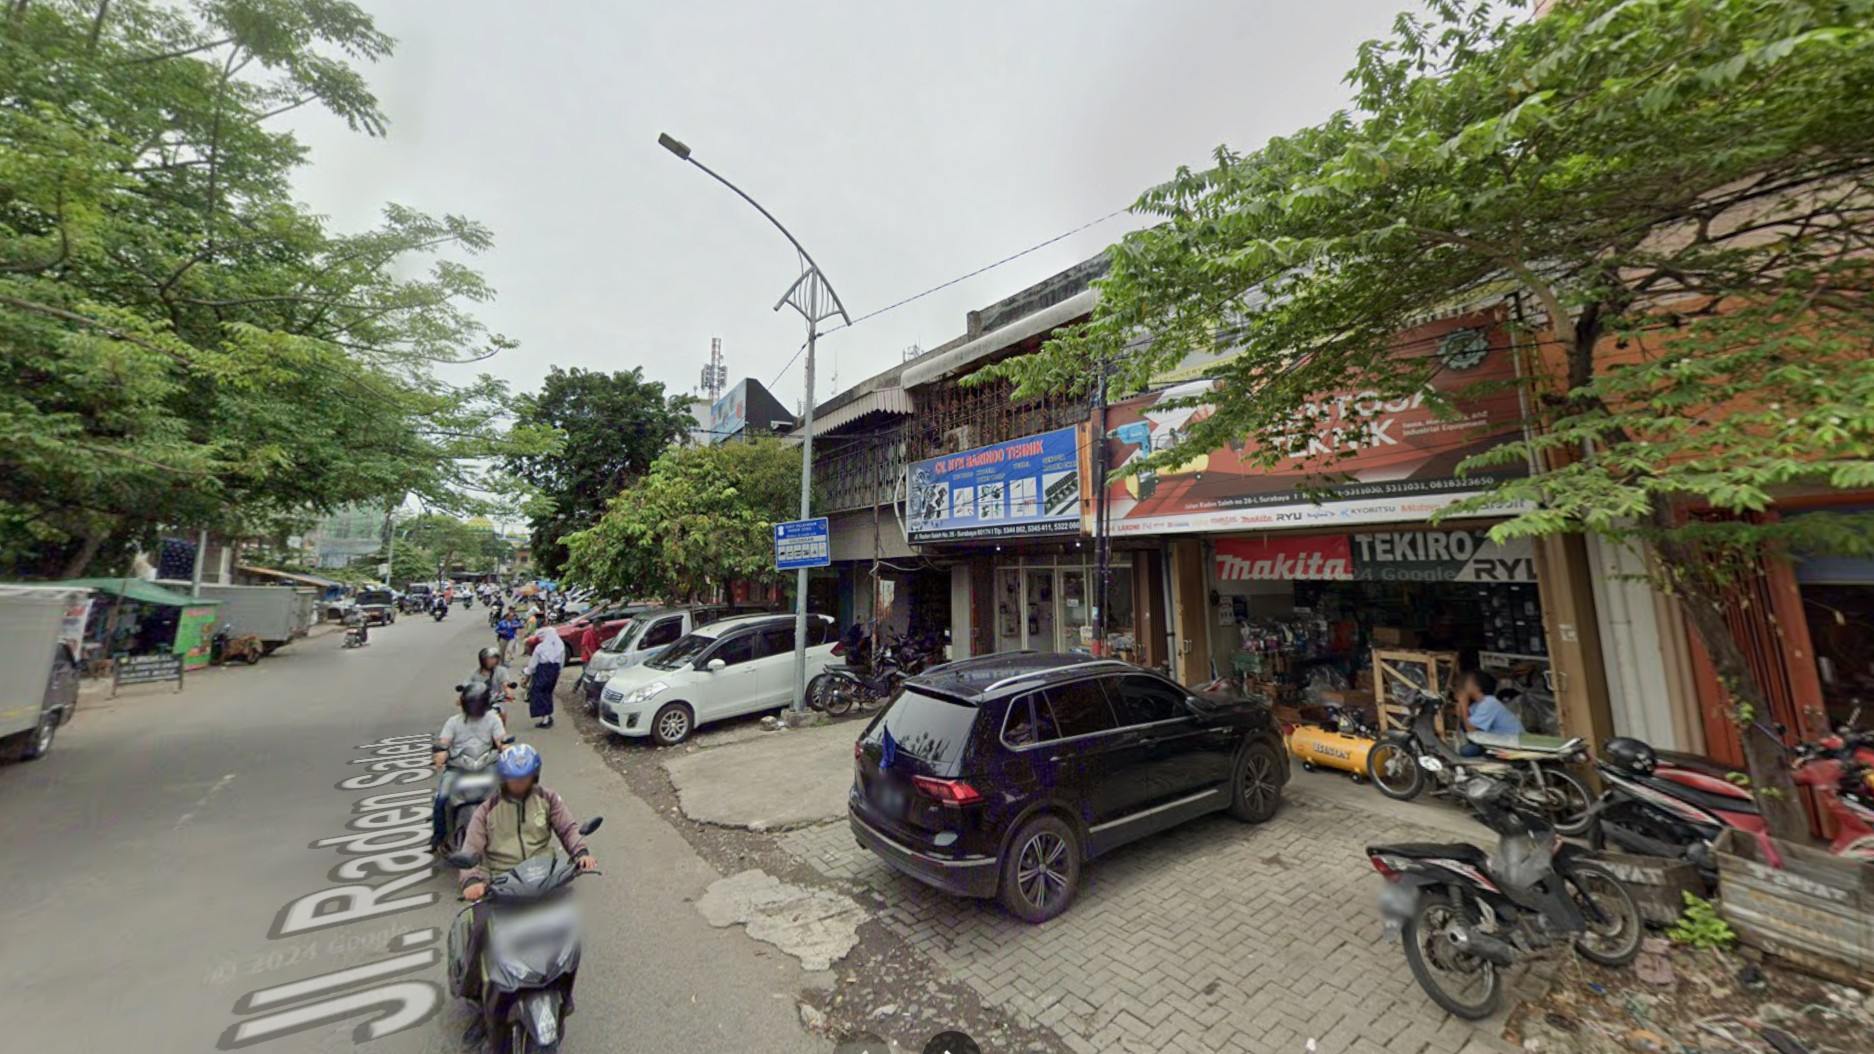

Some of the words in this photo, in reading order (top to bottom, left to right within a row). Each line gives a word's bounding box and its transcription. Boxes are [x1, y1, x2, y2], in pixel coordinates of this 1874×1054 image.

[1259, 493, 1290, 503] Surabaya
[1276, 512, 1302, 521] RYU
[1355, 533, 1473, 561] TEKIRO
